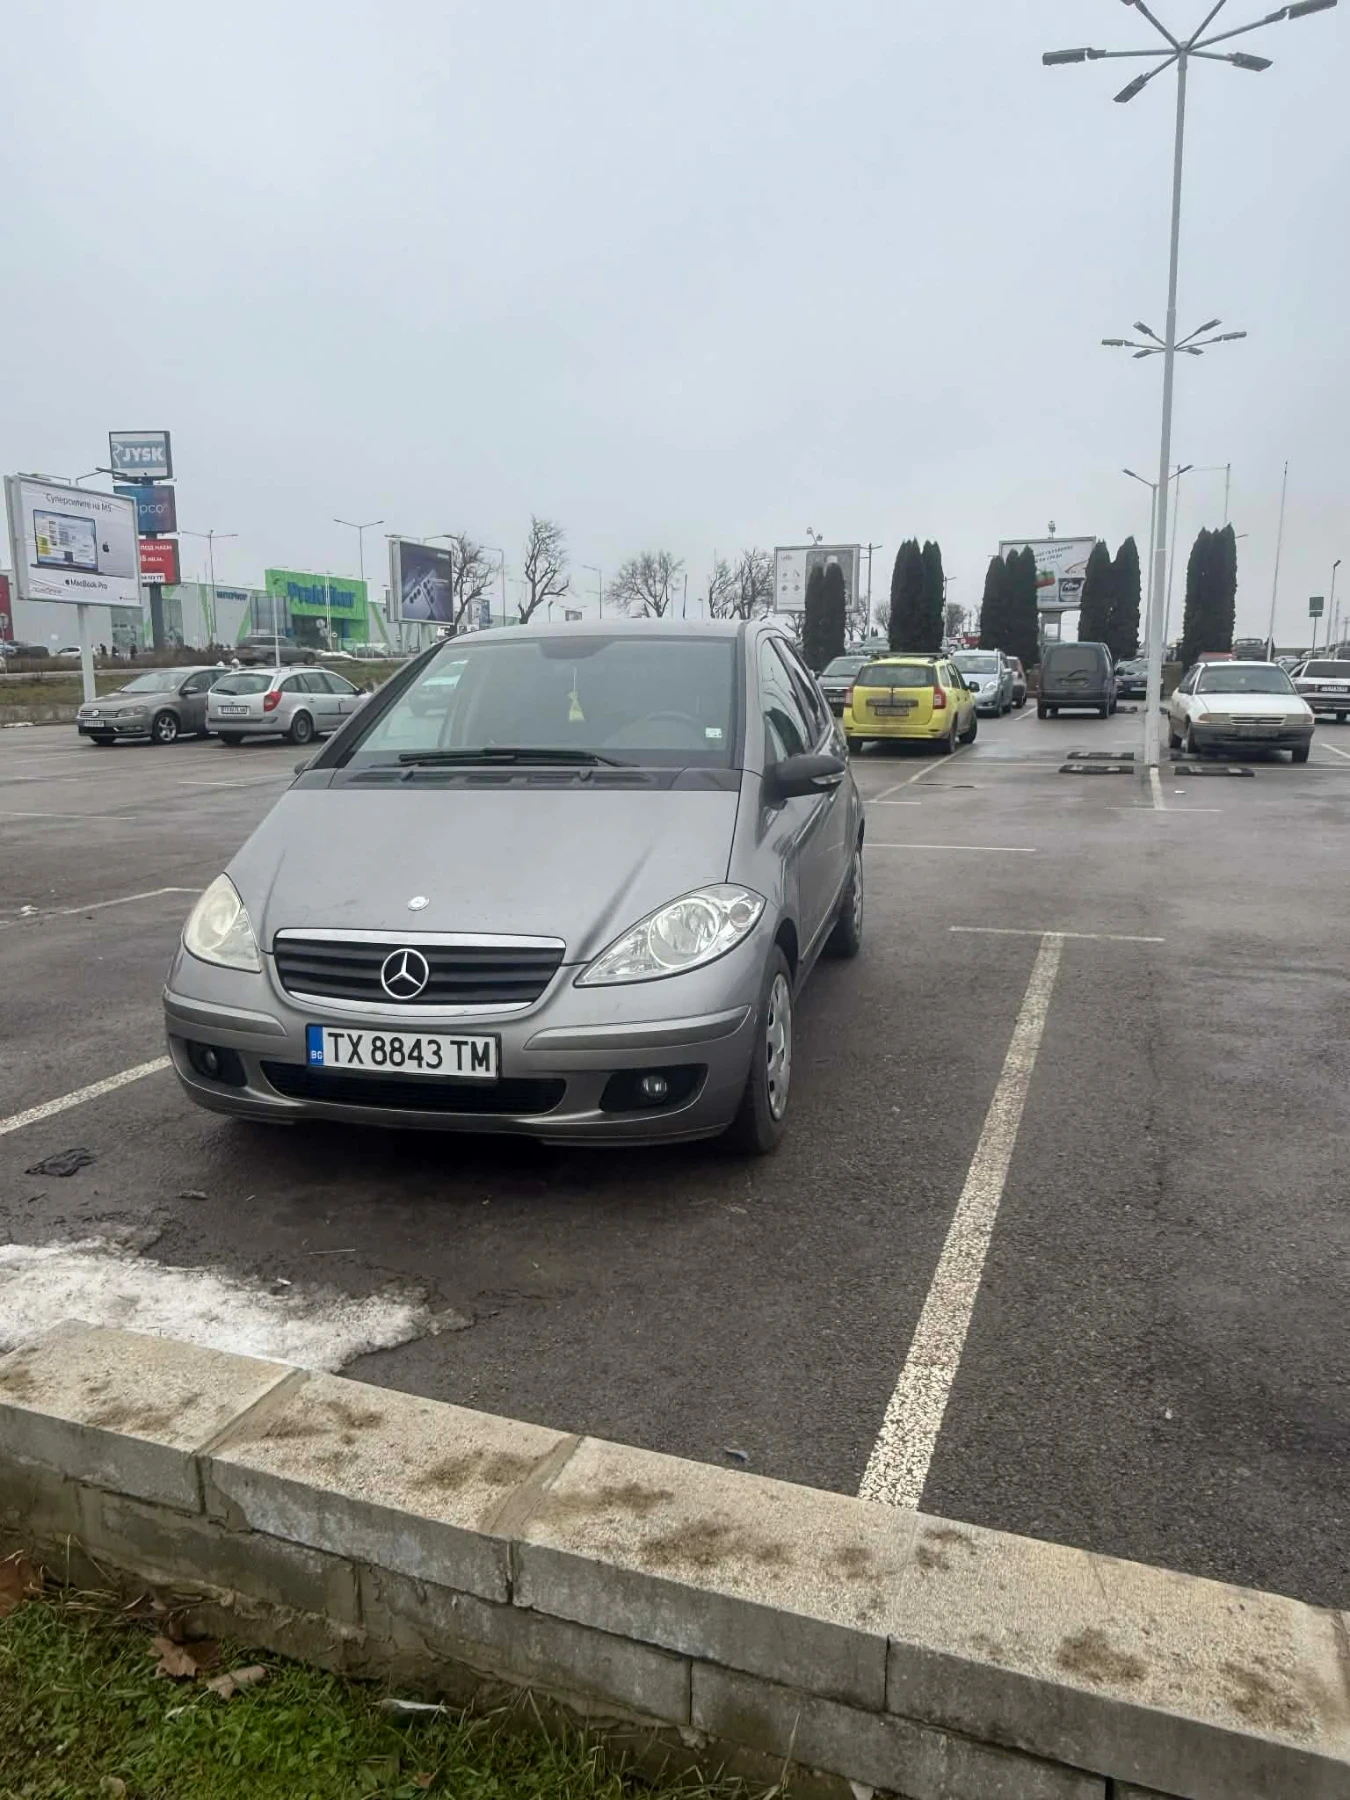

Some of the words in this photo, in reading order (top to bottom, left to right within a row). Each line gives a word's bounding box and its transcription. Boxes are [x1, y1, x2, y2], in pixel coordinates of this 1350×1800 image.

[123, 447, 165, 462] JYSK
[139, 504, 164, 515] pco
[70, 578, 98, 588] MacBook
[98, 582, 108, 590] Pro
[287, 581, 356, 608] Praktiker
[311, 1050, 323, 1060] BG
[328, 1032, 364, 1064] TX
[371, 1035, 443, 1069] 8843
[450, 1040, 491, 1072] TM
